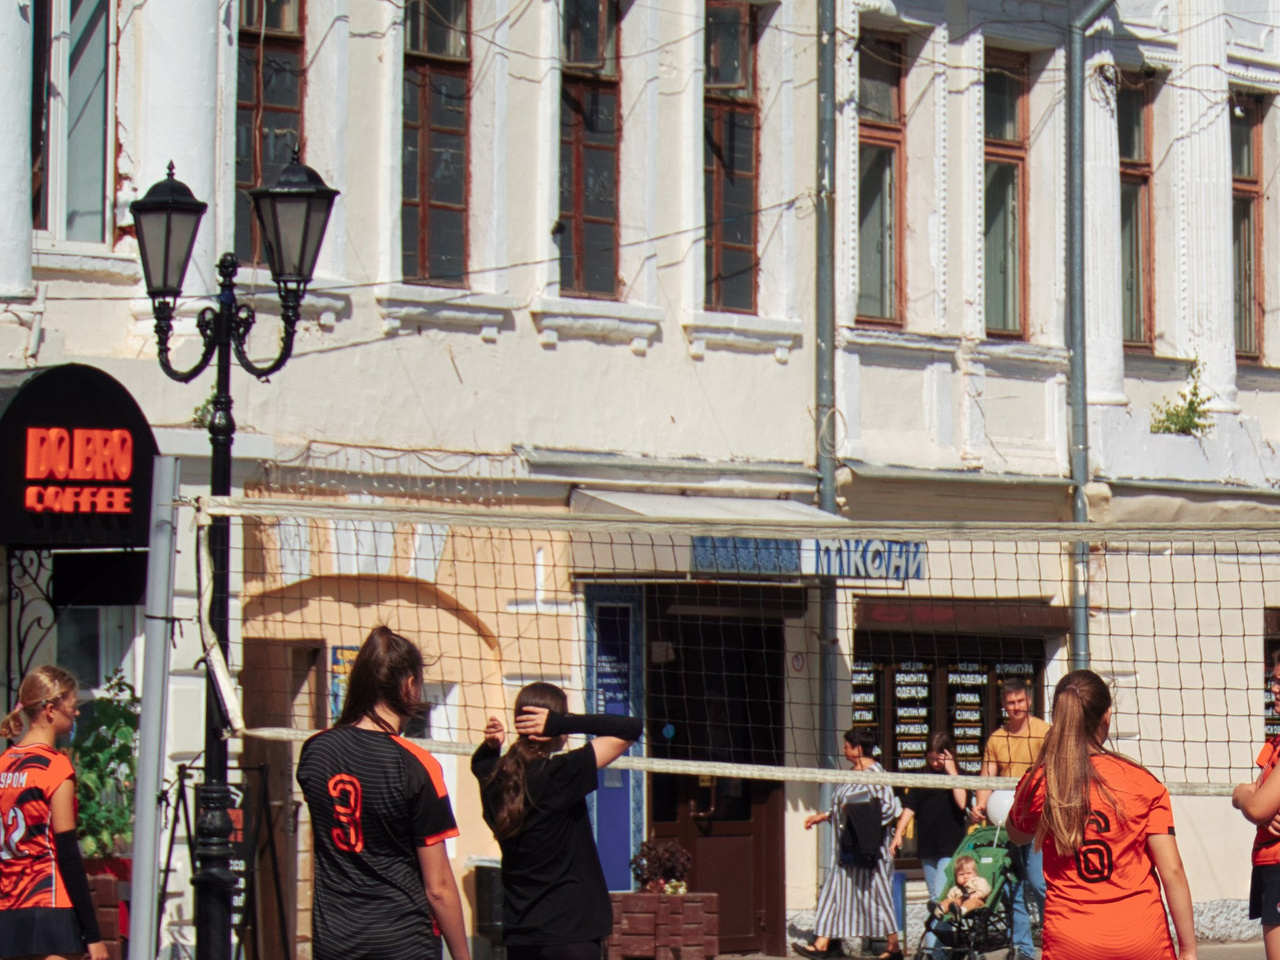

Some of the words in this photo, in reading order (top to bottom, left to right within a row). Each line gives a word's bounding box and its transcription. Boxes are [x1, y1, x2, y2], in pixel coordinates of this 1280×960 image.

[25, 486, 132, 513] COFFEE
[896, 673, 929, 684] РЕМОНТА
[896, 686, 929, 699] ОДЕЖДЫ
[956, 693, 980, 703] ПРЯЖА
[328, 773, 364, 853] 3
[1075, 810, 1113, 883] 6
